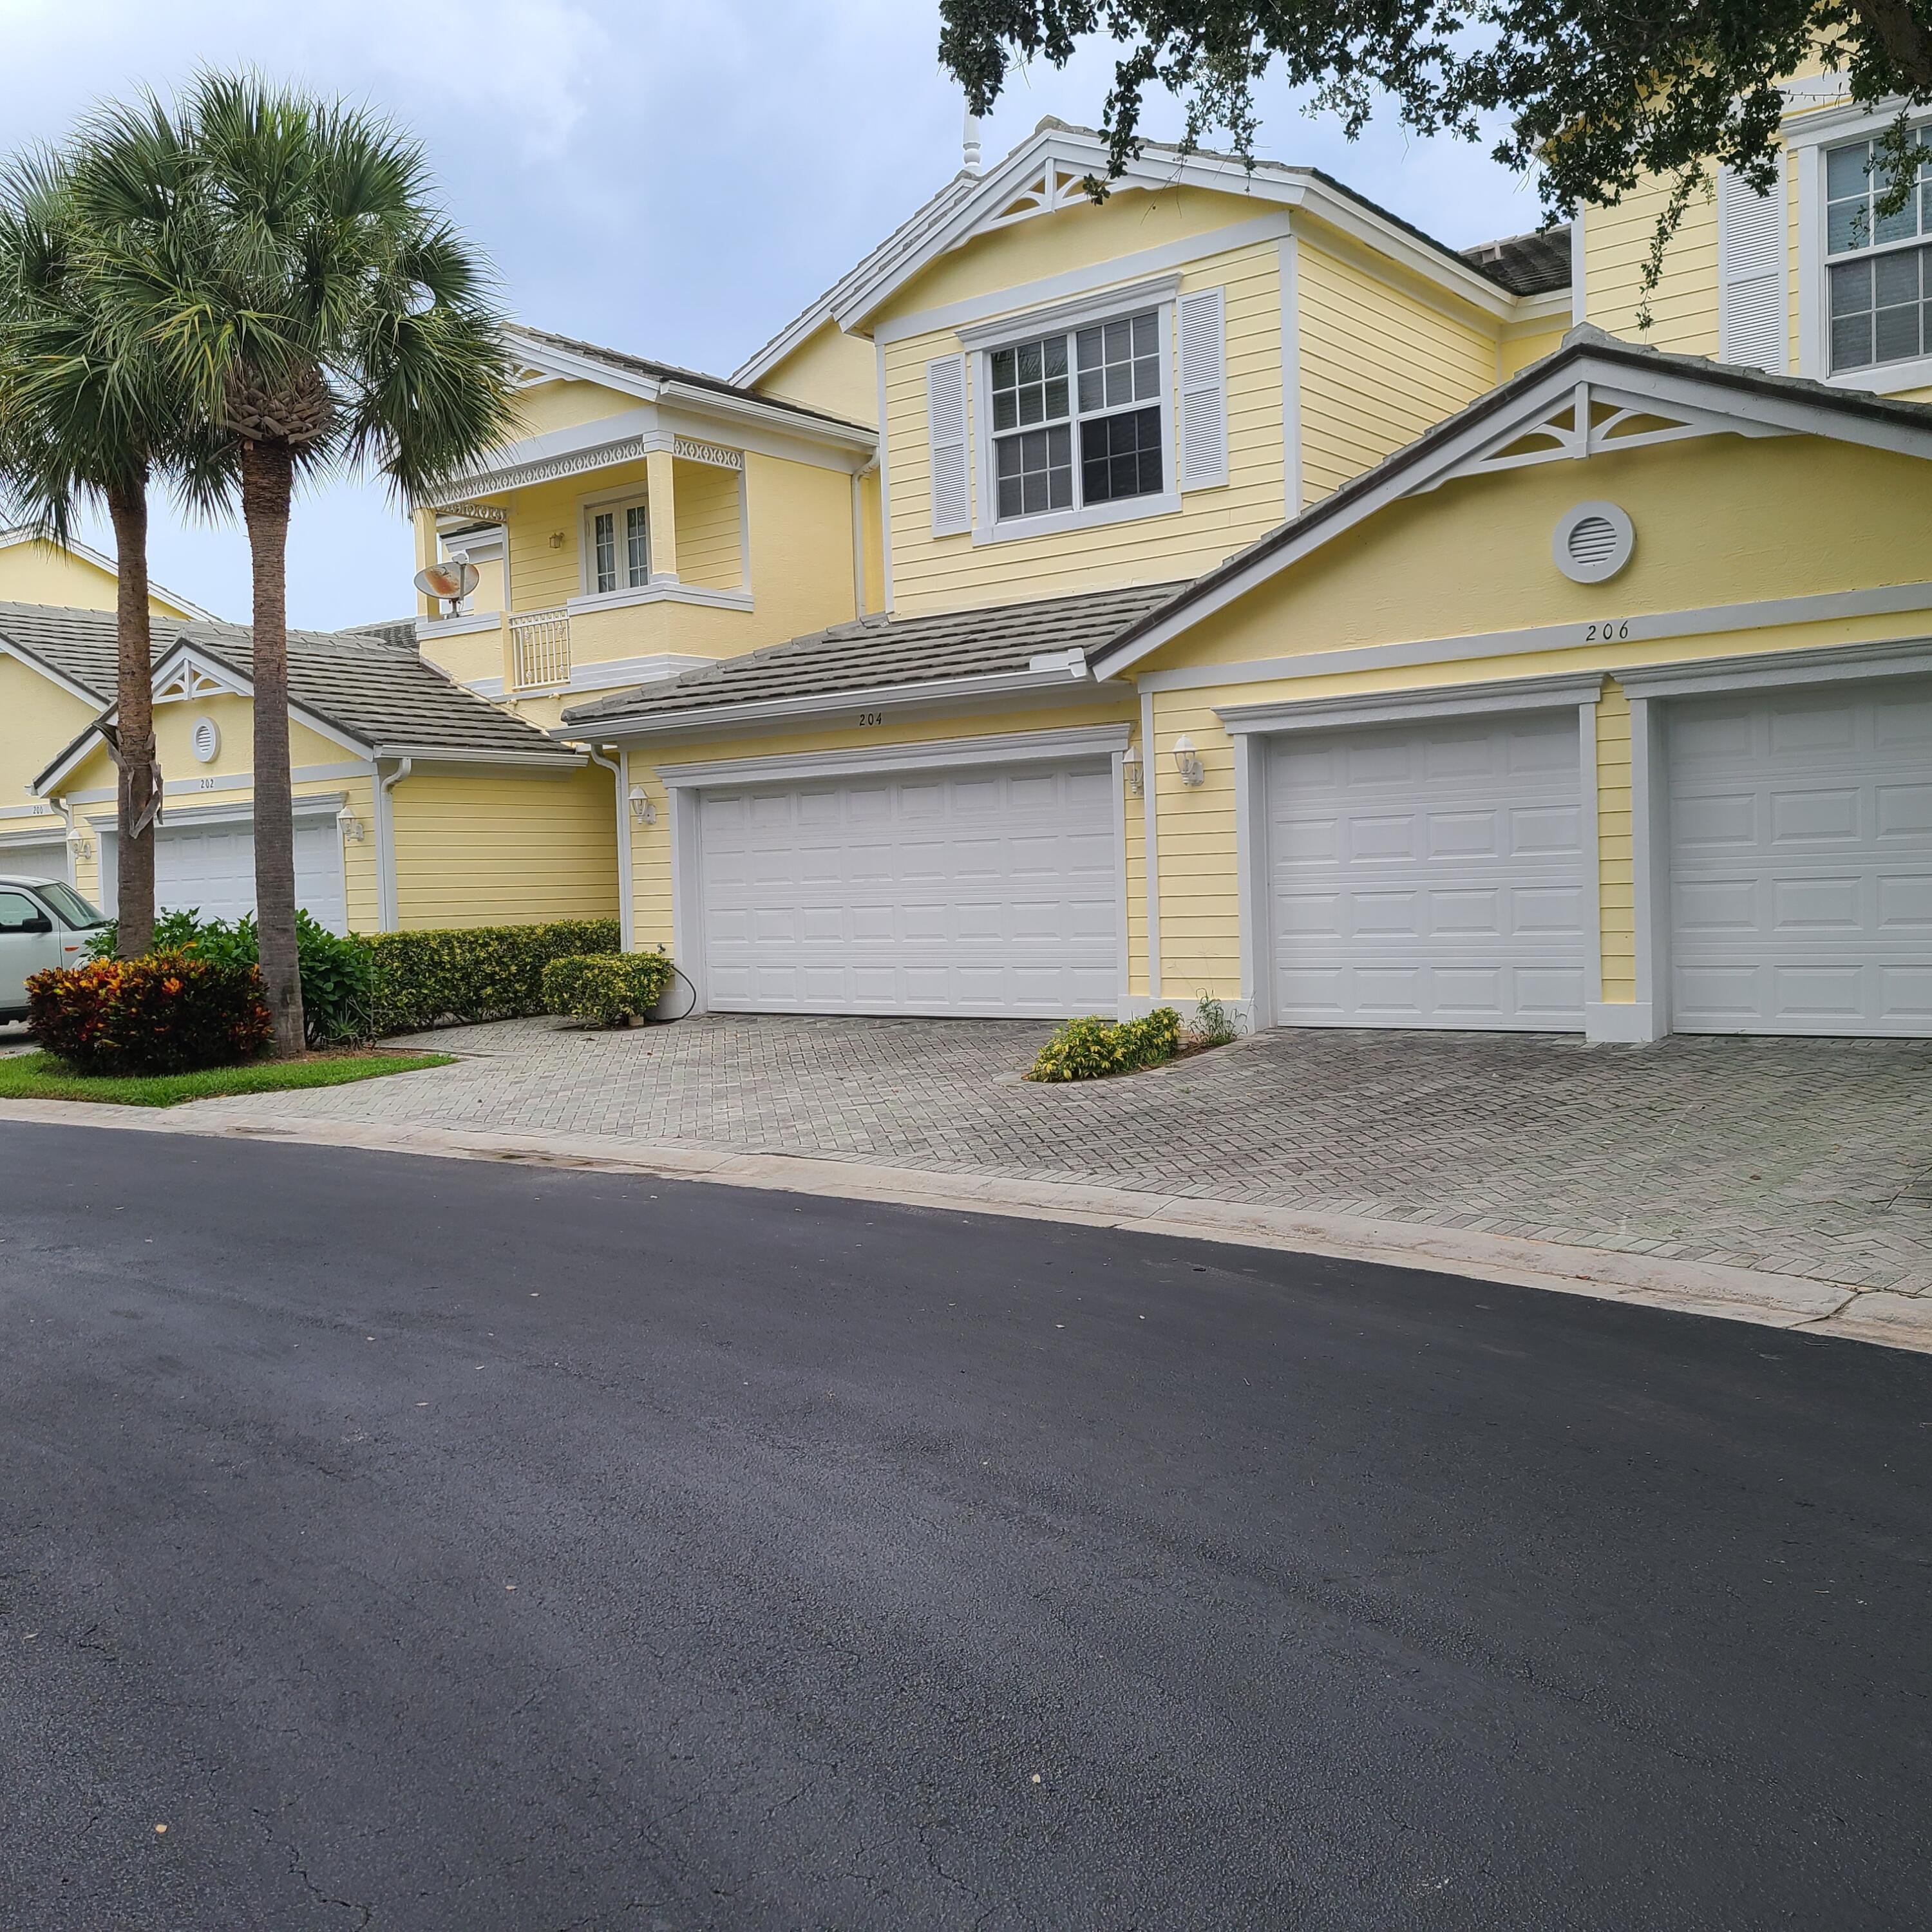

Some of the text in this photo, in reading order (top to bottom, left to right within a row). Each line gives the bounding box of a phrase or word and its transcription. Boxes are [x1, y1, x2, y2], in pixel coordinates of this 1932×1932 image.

[1586, 620, 1629, 641] 206
[859, 712, 882, 726] 204
[200, 779, 214, 789] 202
